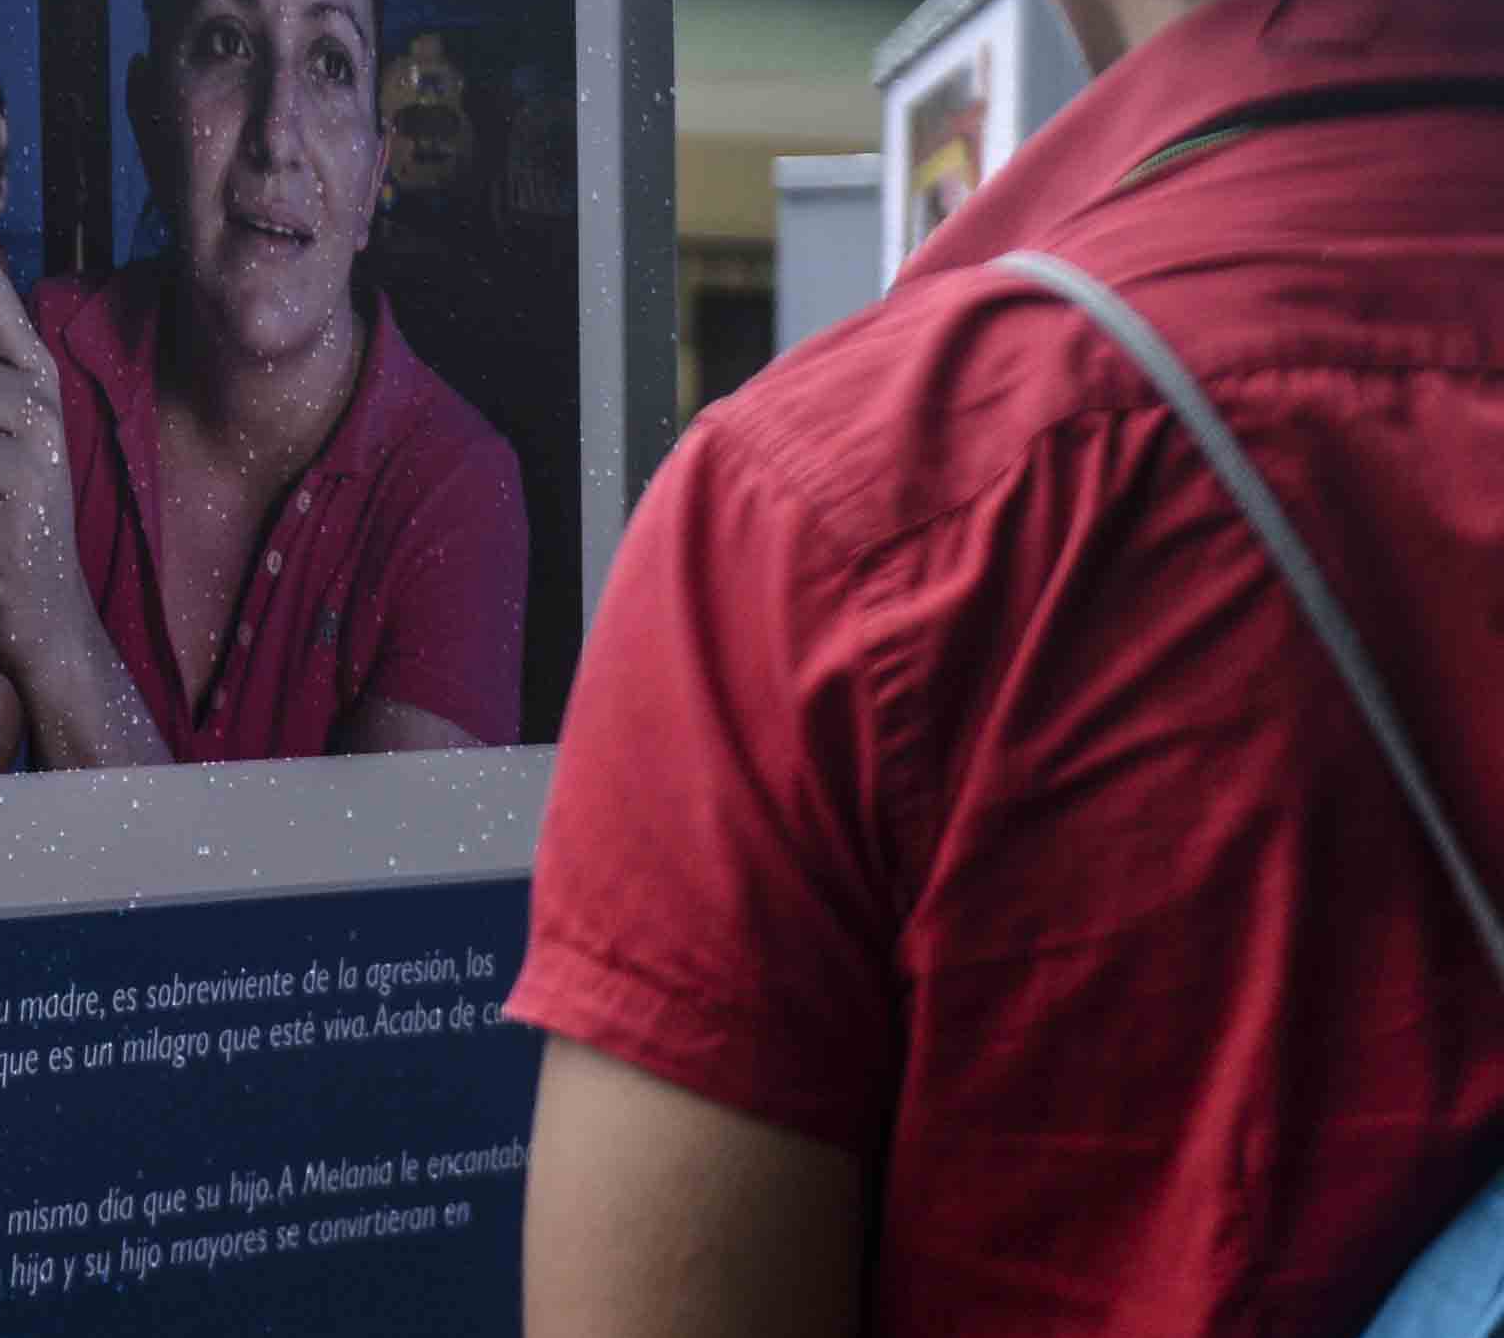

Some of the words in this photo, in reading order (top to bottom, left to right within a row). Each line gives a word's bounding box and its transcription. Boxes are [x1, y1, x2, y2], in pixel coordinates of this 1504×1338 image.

[19, 981, 106, 1023] madre,
[111, 986, 138, 1014] es
[144, 966, 296, 1011] sobreviviente
[301, 958, 331, 996] de
[337, 956, 359, 991] la
[365, 948, 462, 998] agresión,
[464, 945, 496, 979] los
[47, 1046, 74, 1074] es
[82, 1042, 114, 1069] un
[121, 1027, 210, 1070] milagro
[218, 1027, 262, 1065] que
[268, 1012, 316, 1049] esté
[448, 998, 476, 1033] de
[7, 1197, 90, 1236] mismo
[97, 1185, 135, 1225] día
[142, 1187, 188, 1227] que
[195, 1184, 221, 1211] su
[228, 1170, 275, 1215] hijo.
[300, 1154, 394, 1196] Melania
[400, 1150, 420, 1183] le
[9, 1251, 55, 1298] hija
[62, 1255, 77, 1293] y
[84, 1250, 111, 1279] su
[118, 1236, 162, 1282] hijo
[169, 1229, 268, 1270] mayores
[276, 1225, 302, 1251] se
[307, 1204, 437, 1247] convirtieran
[442, 1202, 471, 1228] en
